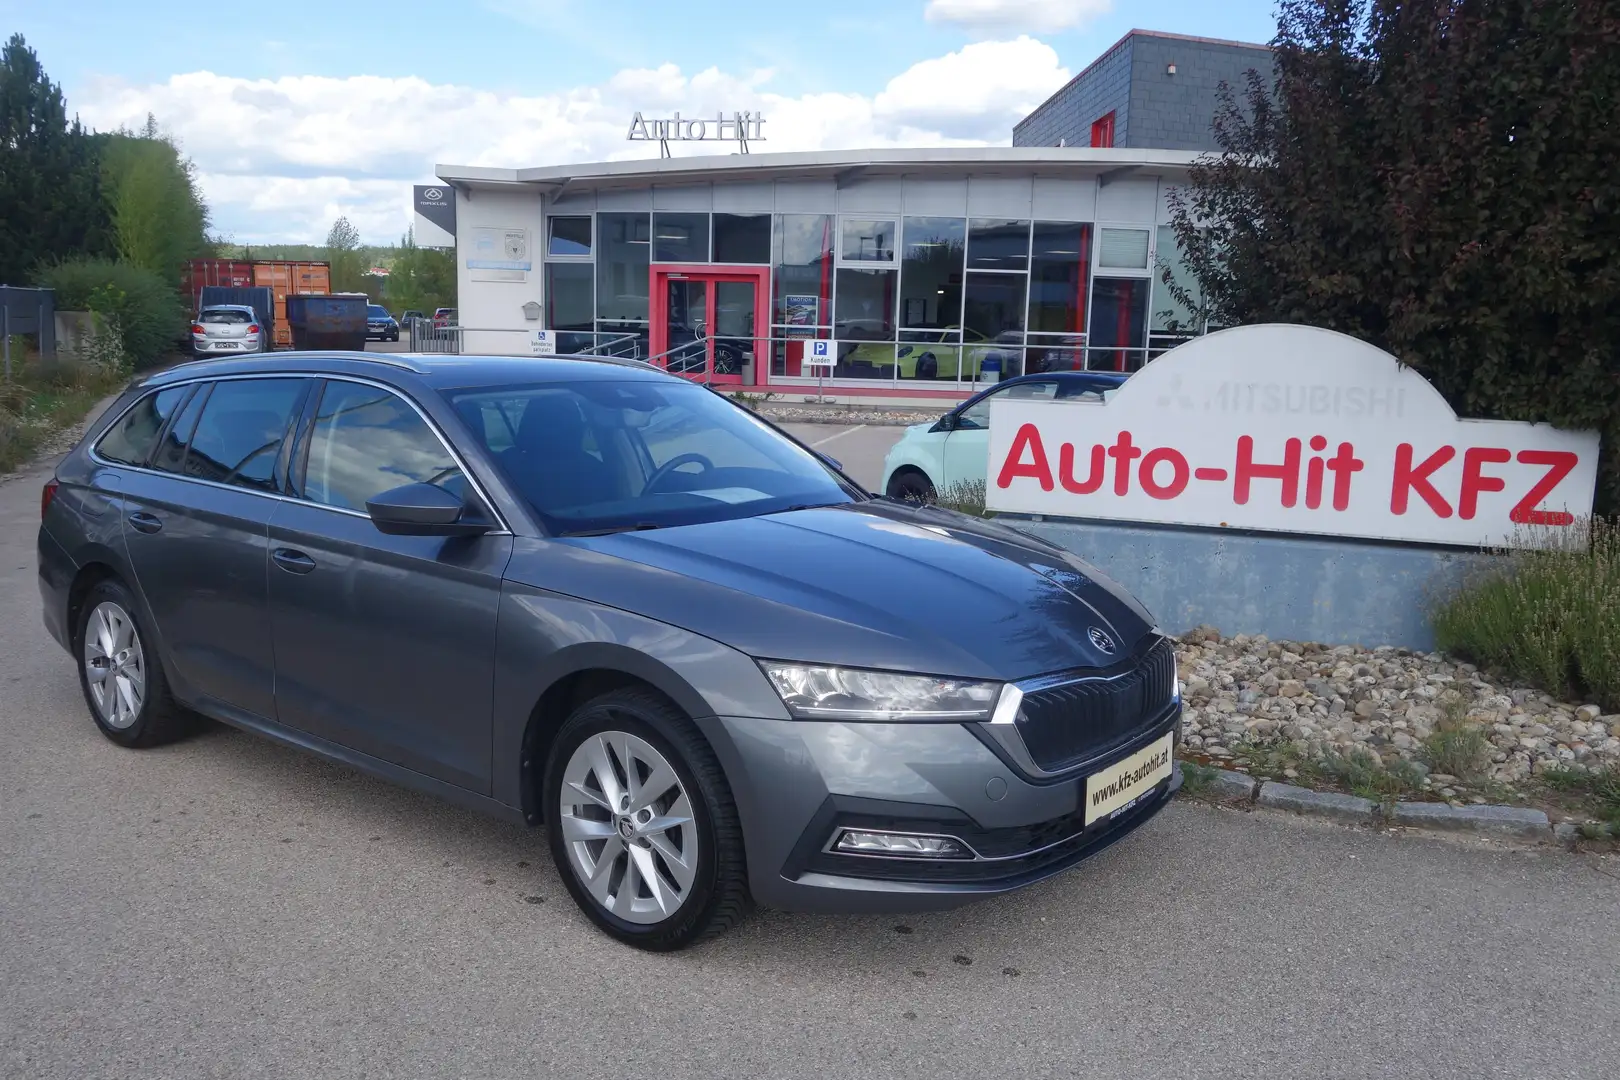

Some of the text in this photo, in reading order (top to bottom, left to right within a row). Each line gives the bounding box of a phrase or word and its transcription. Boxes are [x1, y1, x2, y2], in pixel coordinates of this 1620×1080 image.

[626, 110, 766, 141] Auto Hit
[816, 343, 824, 355] P
[997, 423, 1578, 526] Auto-Hit KFZ
[1092, 745, 1168, 806] www.kfz-autohit.at
